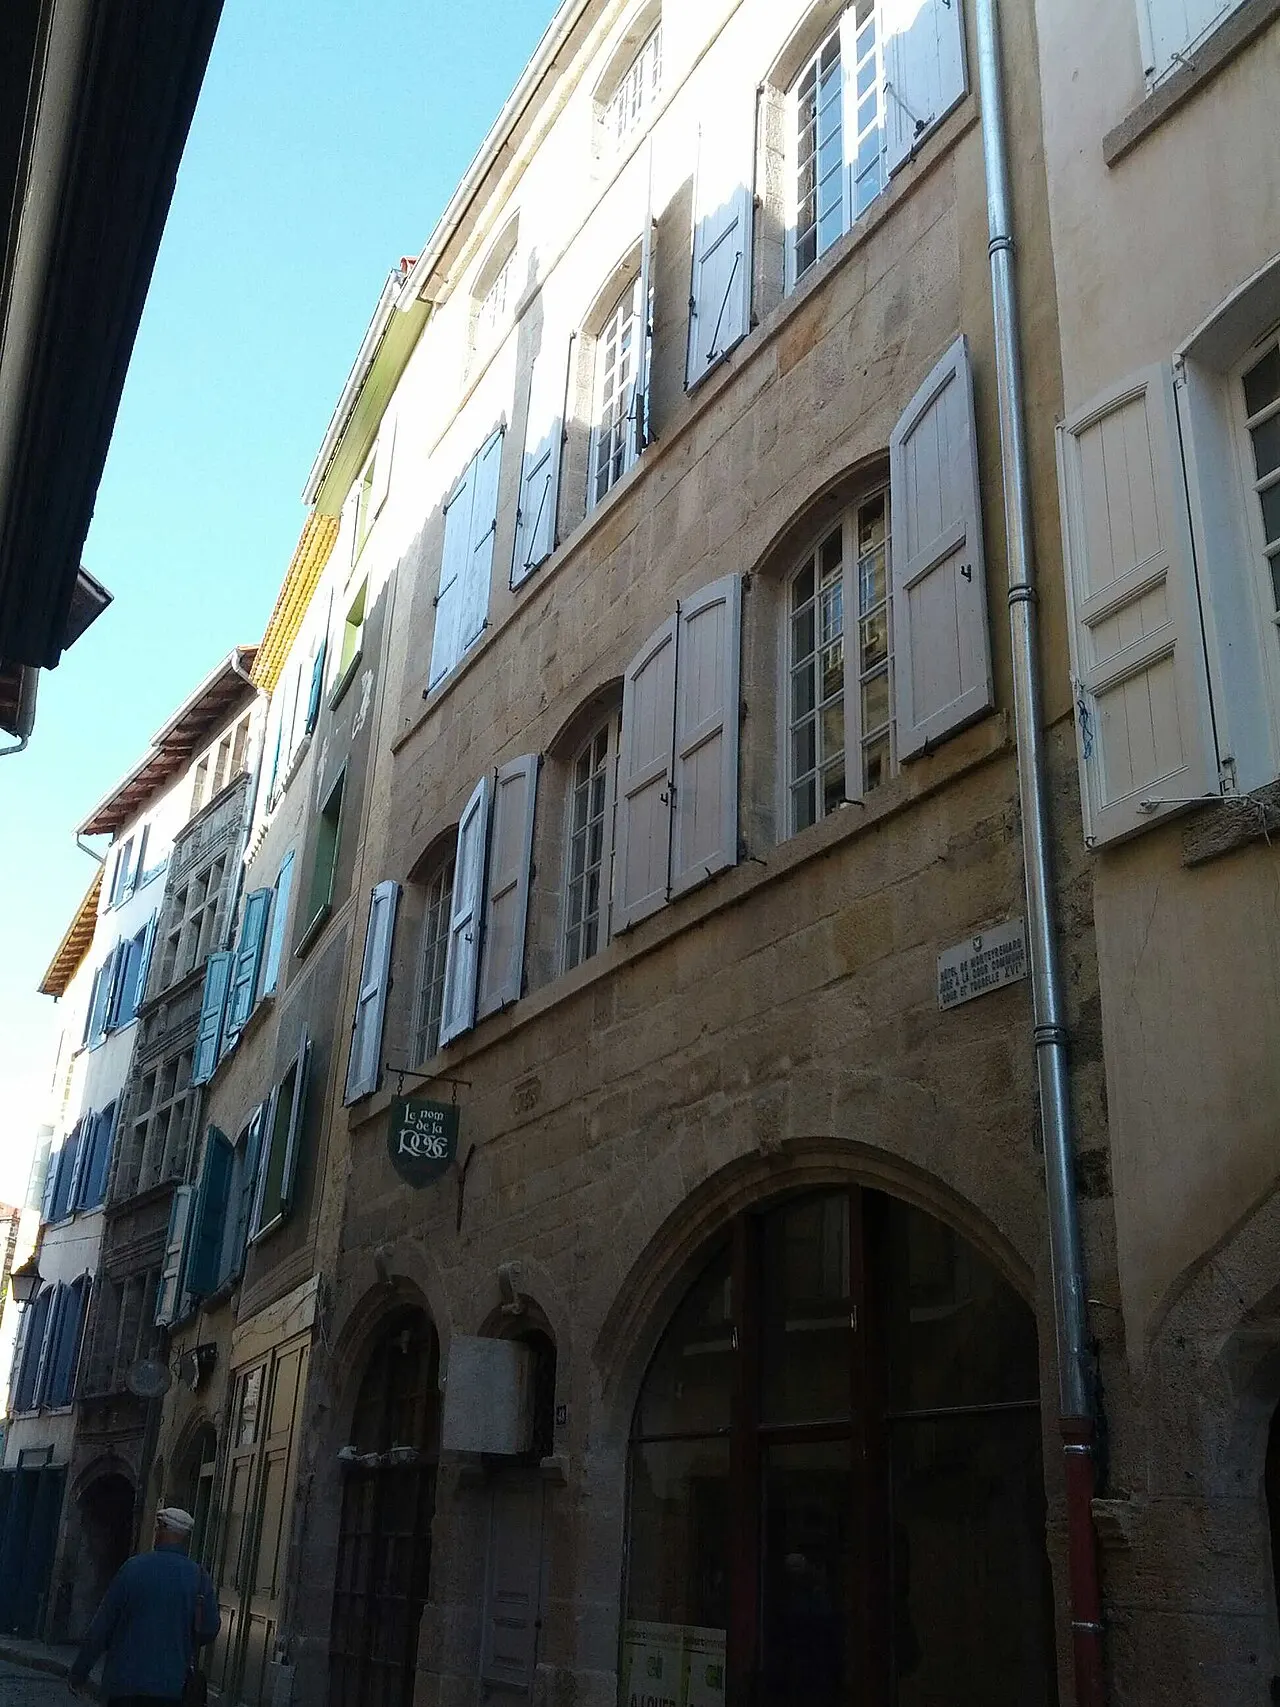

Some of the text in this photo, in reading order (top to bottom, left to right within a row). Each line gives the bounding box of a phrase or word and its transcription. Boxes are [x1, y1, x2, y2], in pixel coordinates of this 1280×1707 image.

[960, 961, 968, 973] DE
[960, 985, 968, 997] ET
[404, 1102, 444, 1124] Le nom
[416, 1119, 443, 1134] de la
